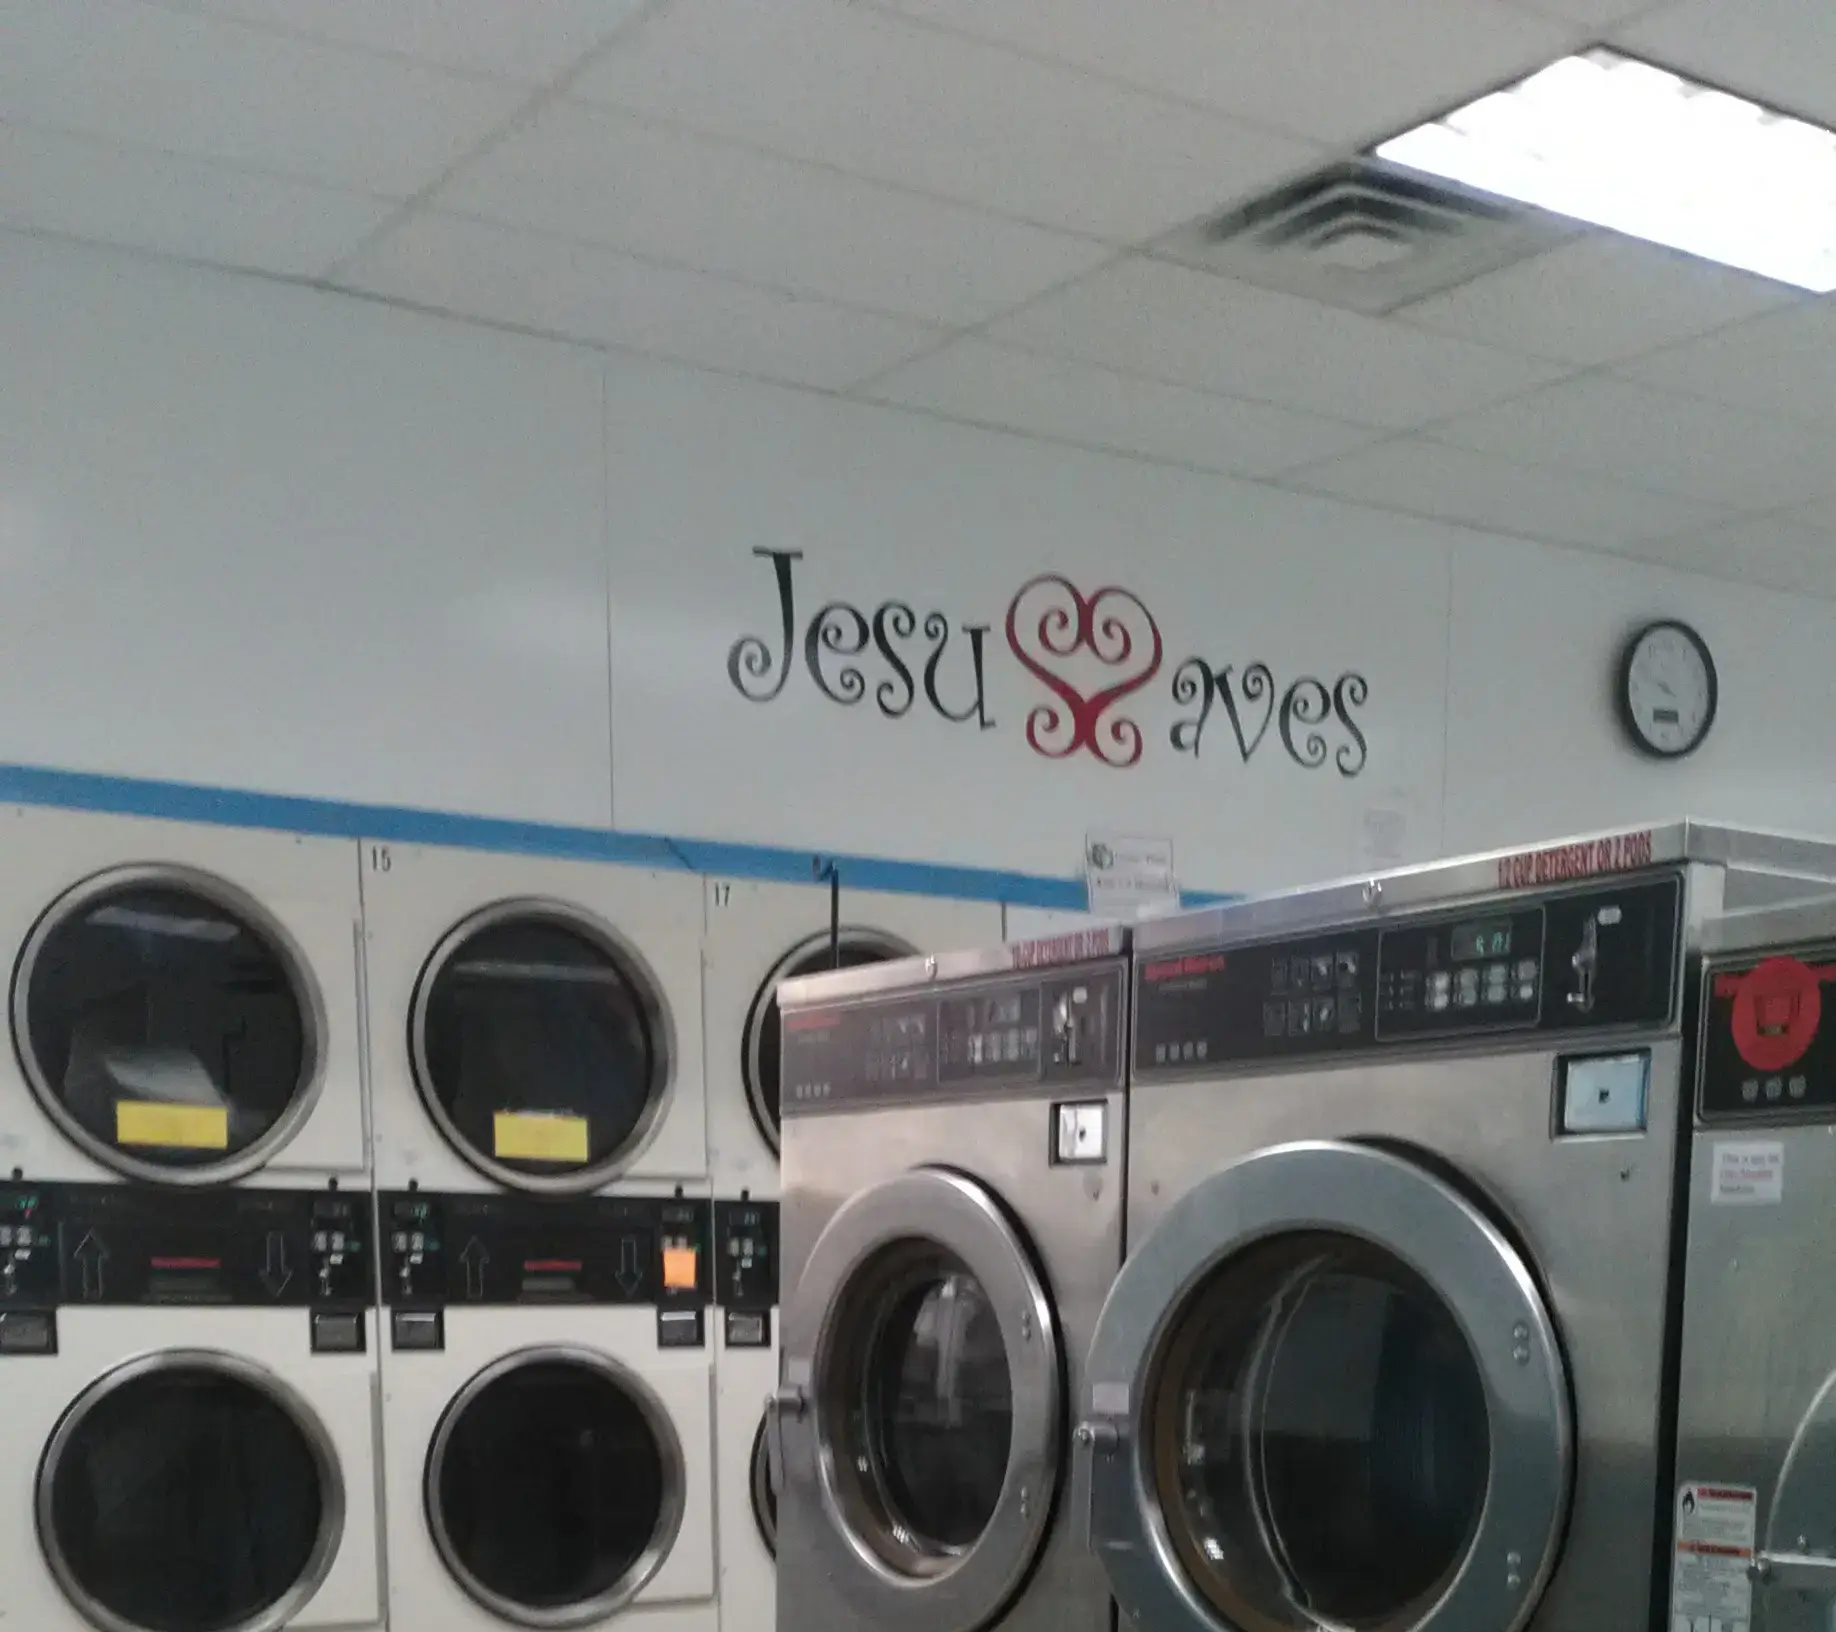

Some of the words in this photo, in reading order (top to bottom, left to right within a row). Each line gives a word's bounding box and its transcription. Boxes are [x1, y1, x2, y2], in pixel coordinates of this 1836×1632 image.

[372, 845, 391, 872] 15
[1534, 840, 1594, 884] DETERGENT
[1596, 837, 1612, 873] OR
[1623, 829, 1652, 870] PODS
[714, 881, 731, 907] 17
